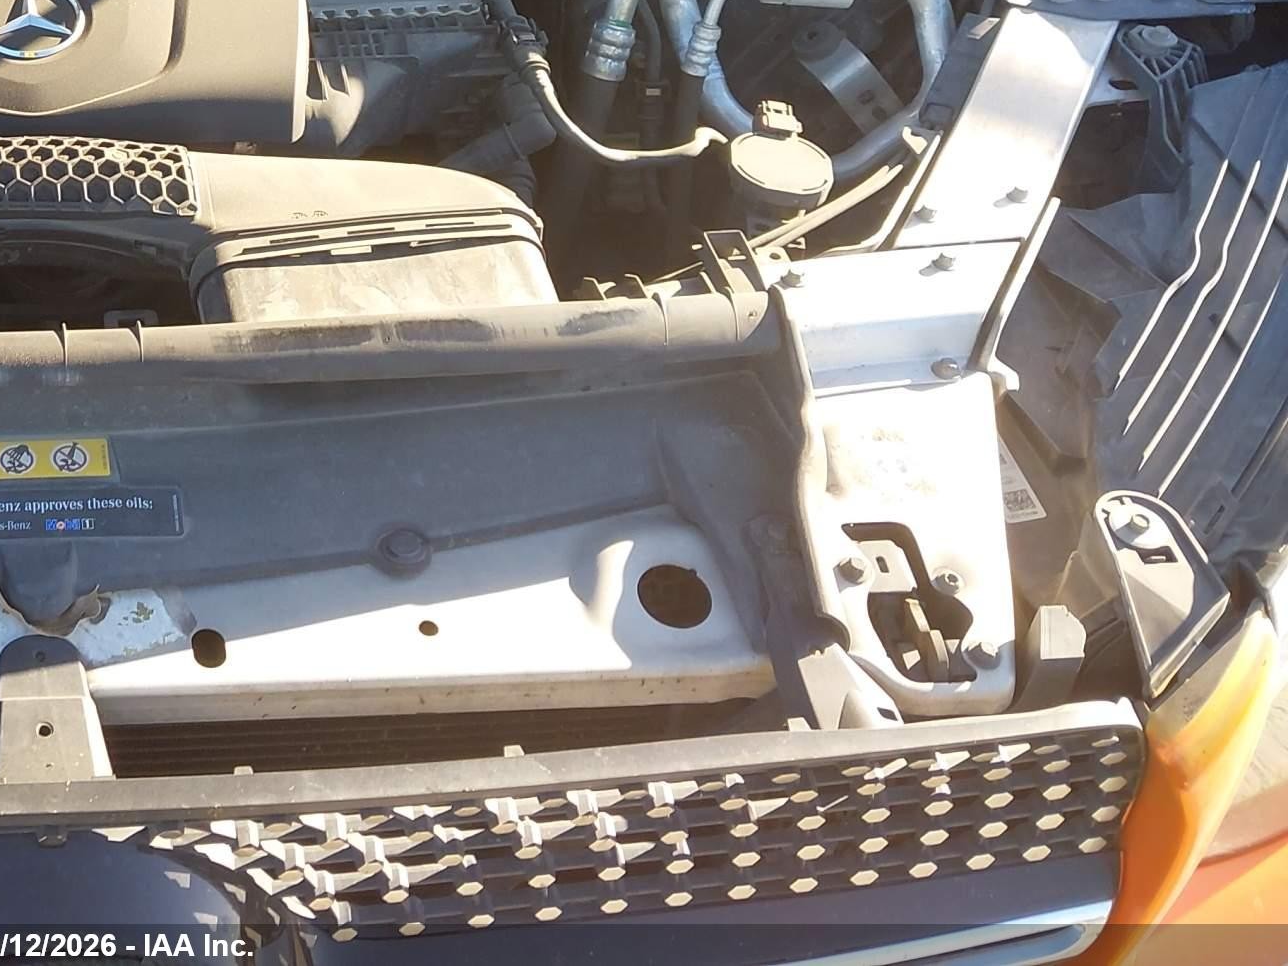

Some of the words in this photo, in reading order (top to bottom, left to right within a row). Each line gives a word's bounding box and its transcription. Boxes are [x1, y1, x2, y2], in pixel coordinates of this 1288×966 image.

[24, 499, 83, 514] approves
[87, 497, 123, 510] these
[126, 496, 153, 510] oils:
